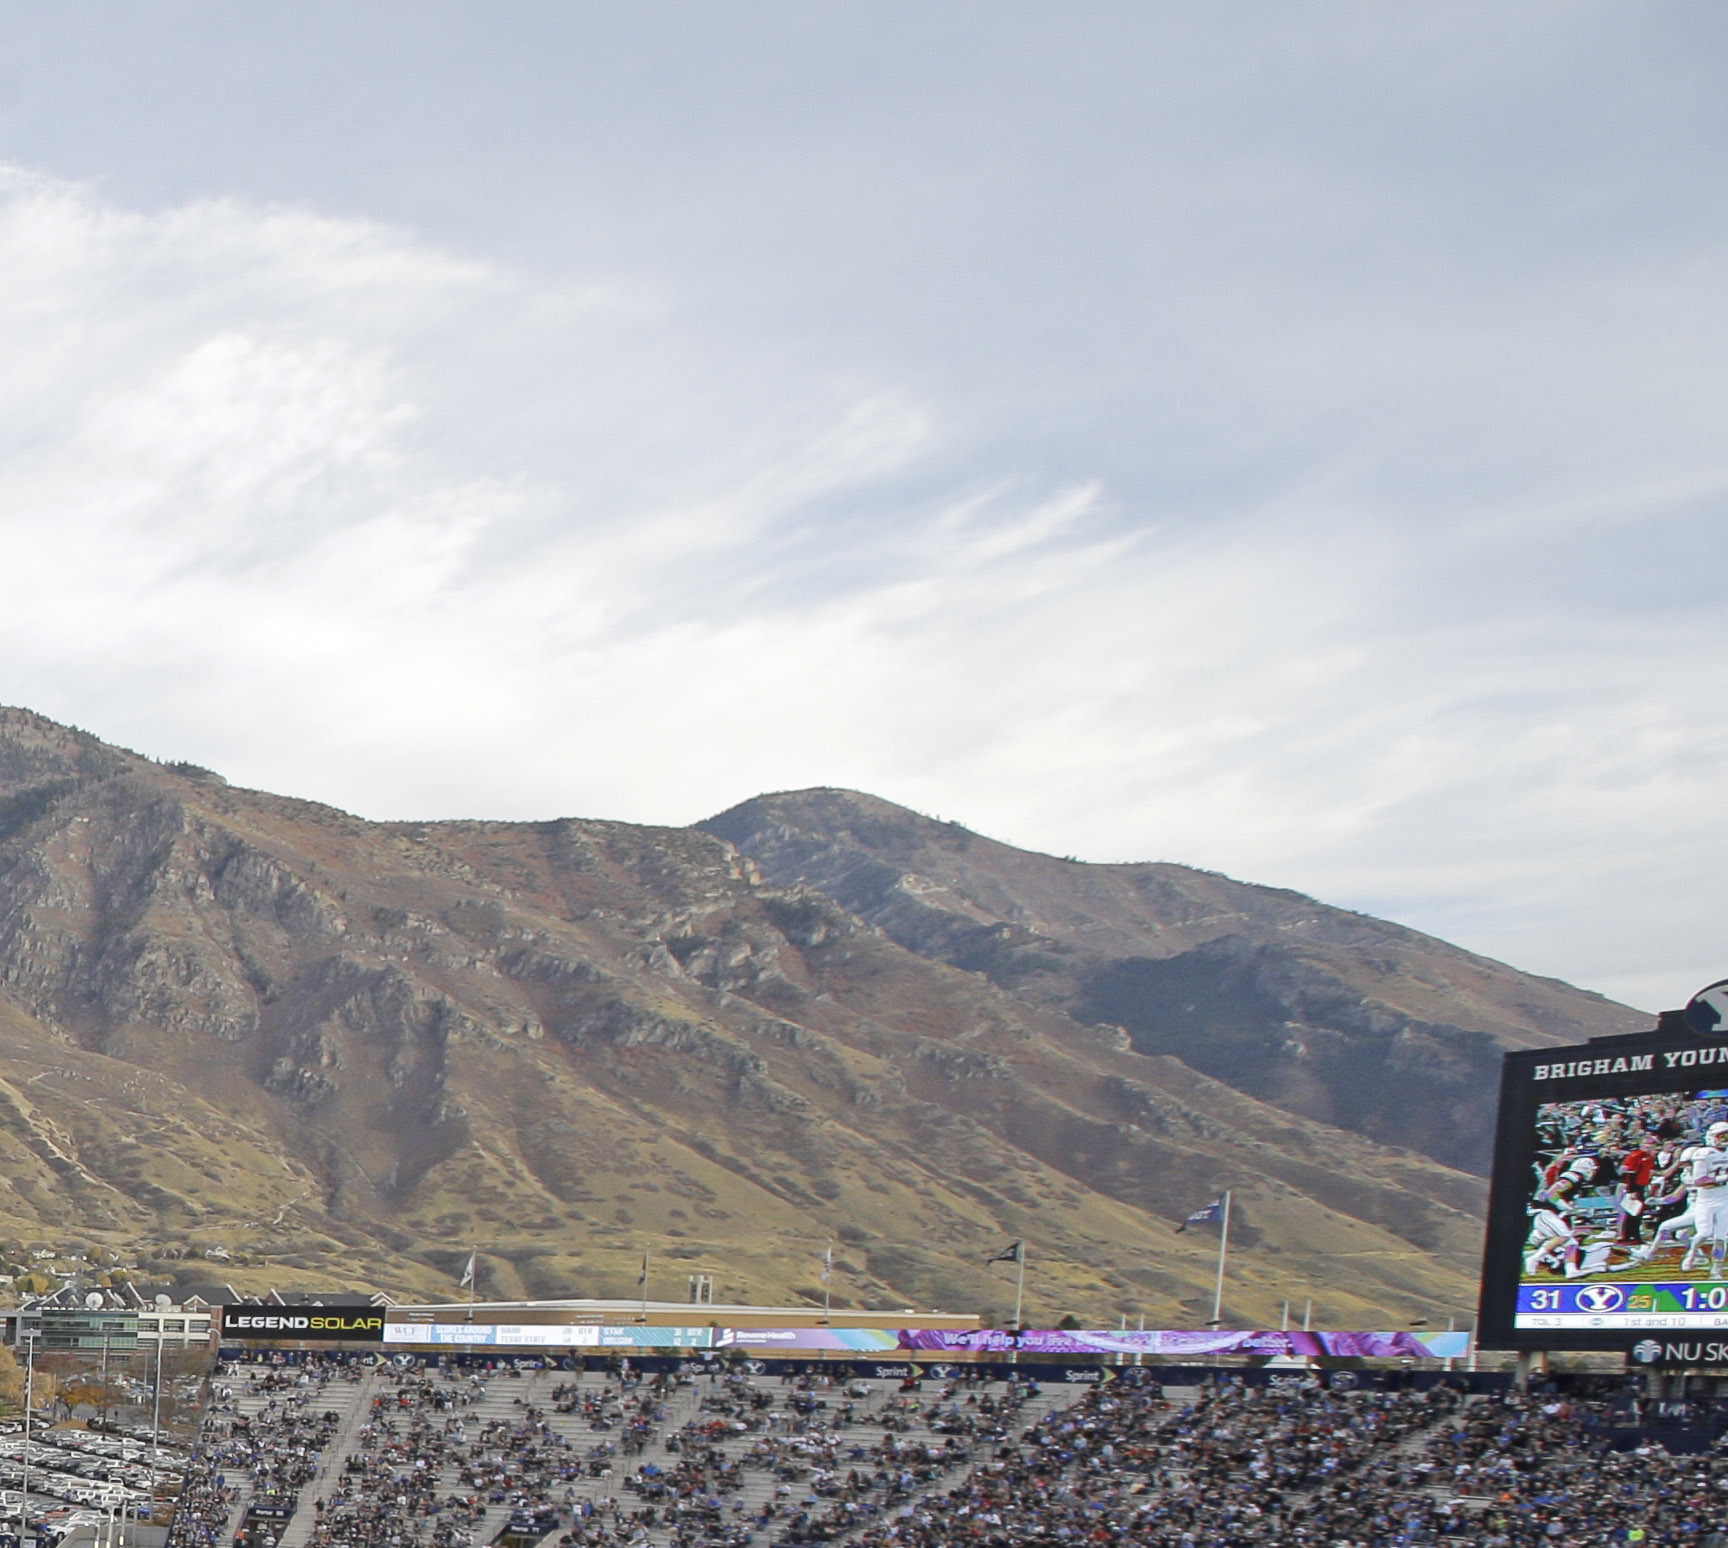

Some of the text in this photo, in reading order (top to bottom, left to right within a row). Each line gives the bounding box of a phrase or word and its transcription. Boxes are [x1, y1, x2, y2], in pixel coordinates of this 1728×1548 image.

[1534, 1055, 1653, 1080] BRIGHAM
[1531, 1289, 1561, 1310] 31
[1627, 1295, 1652, 1311] 25
[1682, 1288, 1728, 1310] 1:0
[1672, 1317, 1686, 1327] 10
[1665, 1342, 1700, 1361] NU
[876, 1366, 908, 1378] Sprint
[1065, 1370, 1100, 1382] Sprint
